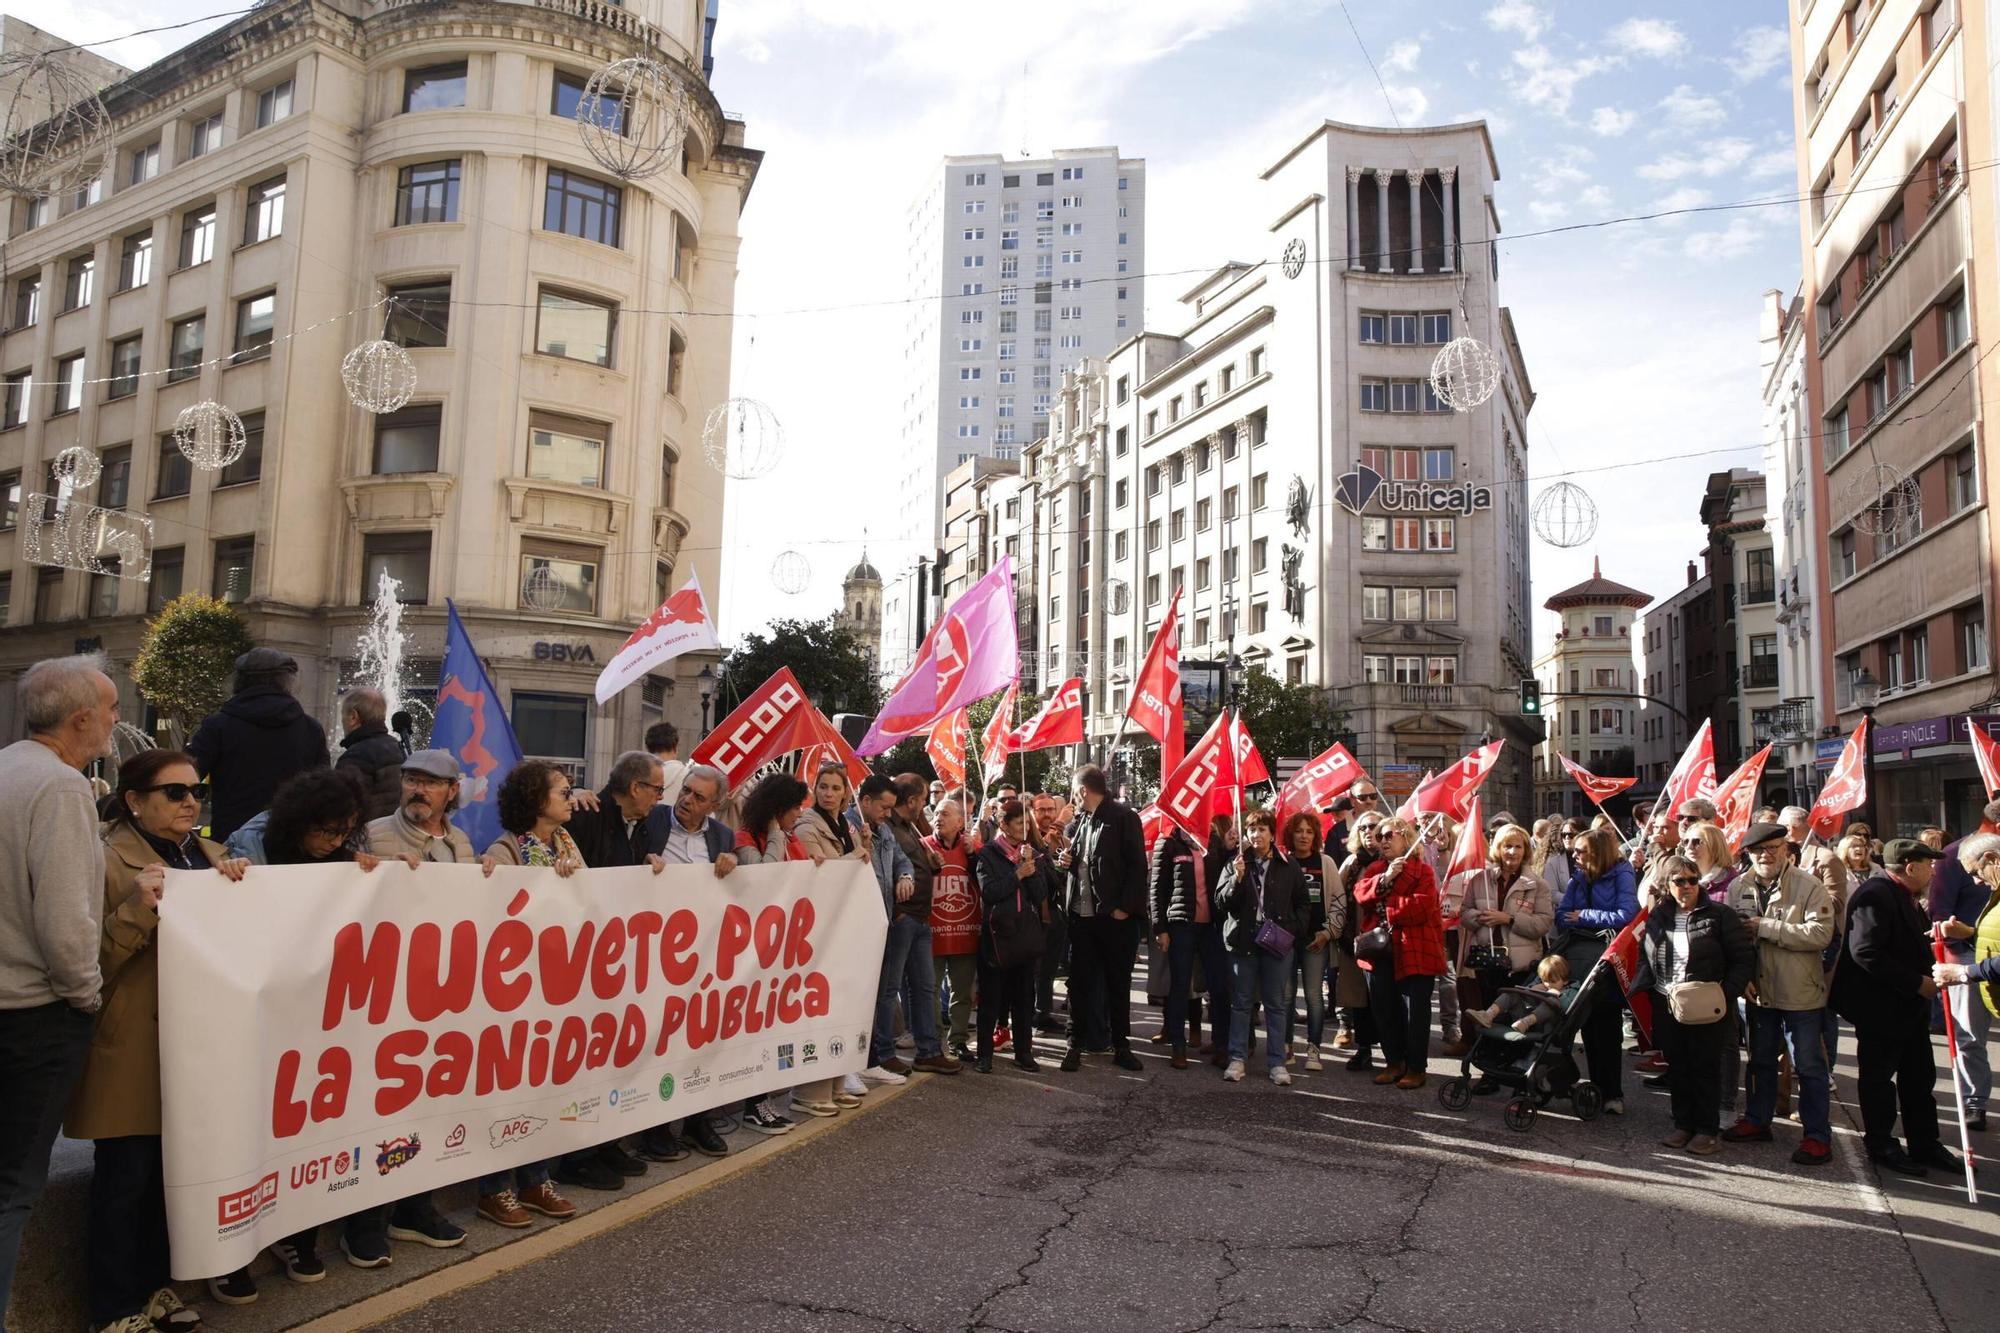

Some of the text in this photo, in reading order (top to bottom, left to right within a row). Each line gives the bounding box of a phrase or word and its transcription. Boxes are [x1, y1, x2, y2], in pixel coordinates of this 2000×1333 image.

[1379, 482, 1492, 517] Unicaja
[534, 642, 595, 661] BBVA
[710, 681, 802, 774] CCOO
[1902, 725, 1937, 743] PIÑOLE
[932, 875, 969, 897] UGT
[716, 897, 816, 982] POR
[502, 1121, 531, 1139] APG
[290, 1155, 333, 1190] UGT
[327, 1176, 360, 1193] Asturias
